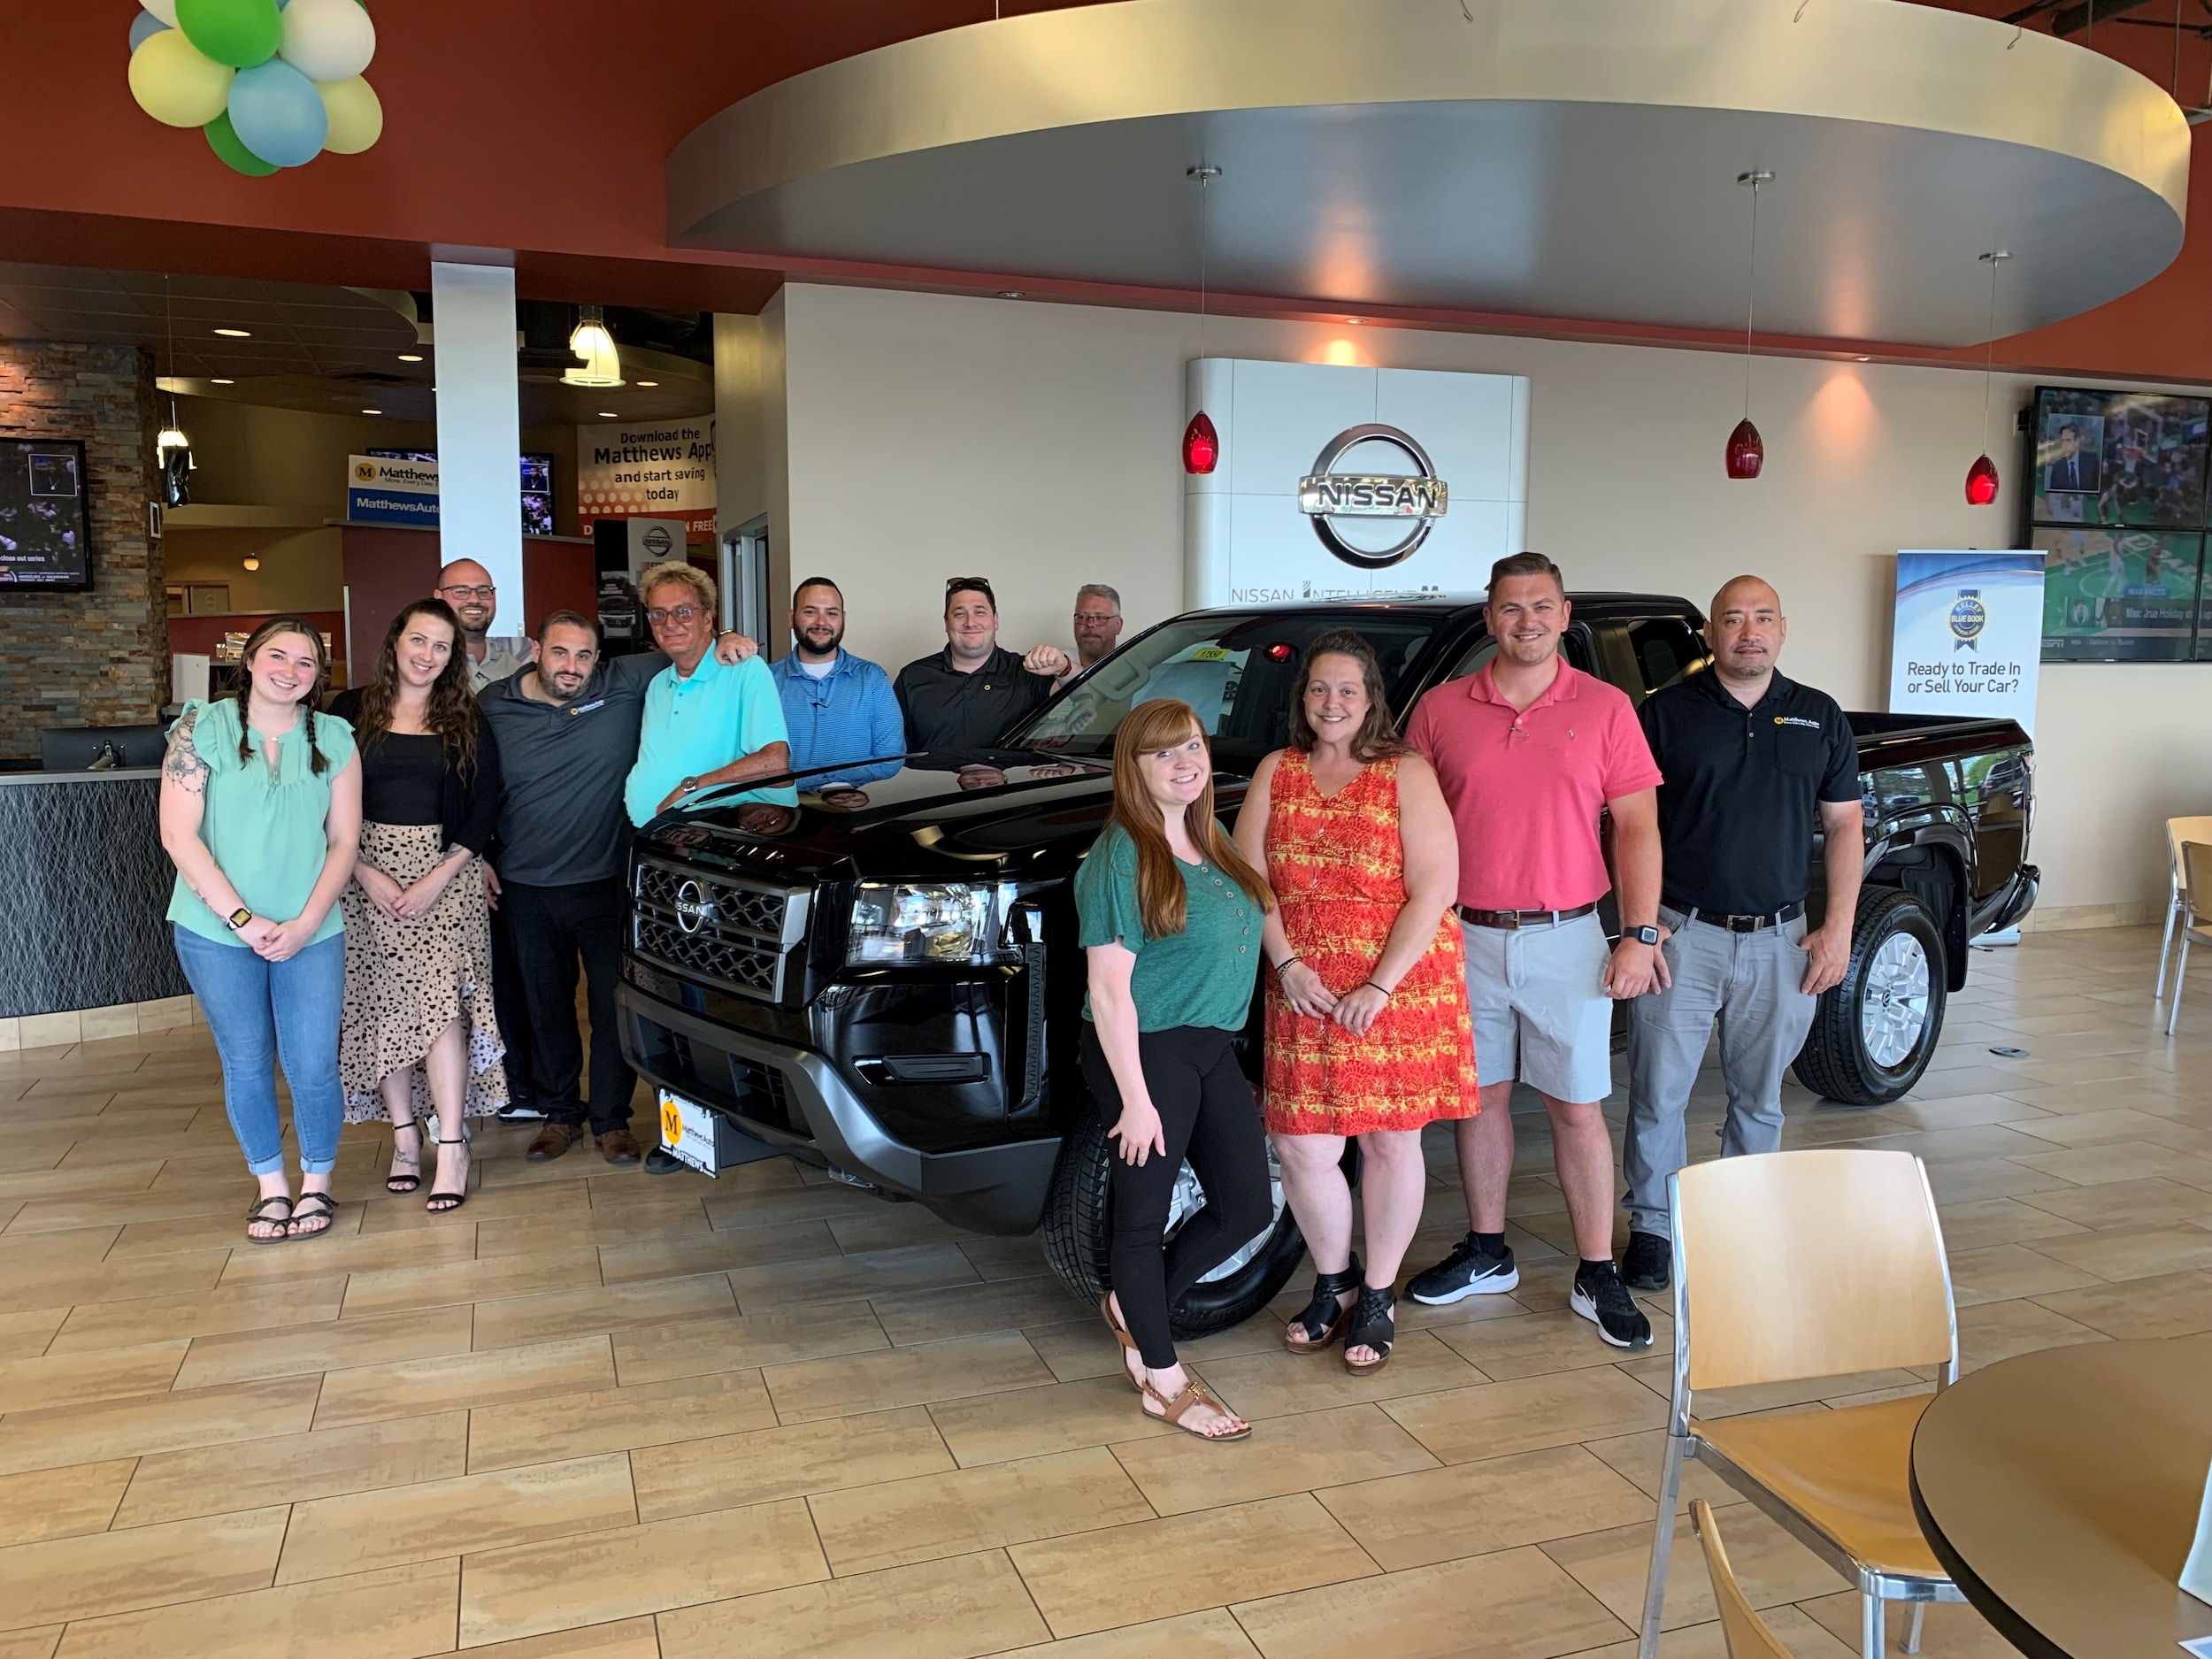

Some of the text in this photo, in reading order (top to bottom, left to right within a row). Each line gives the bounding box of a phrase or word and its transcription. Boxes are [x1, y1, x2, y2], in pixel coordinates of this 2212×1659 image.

[620, 428, 700, 443] Download the
[594, 442, 711, 465] Matthews App
[379, 466, 439, 482] Matthews
[615, 467, 705, 483] and start saving
[646, 487, 680, 502] today
[1317, 482, 1436, 508] NISSAN
[693, 519, 713, 533] FREE
[1231, 588, 1294, 603] NISSAN
[1955, 601, 1983, 613] KELLEY
[1908, 661, 2022, 679] Ready to Trade In
[1908, 679, 2019, 693] or Sell Your Car?
[664, 1110, 679, 1136] M
[672, 1146, 705, 1173] MATTHEWS
